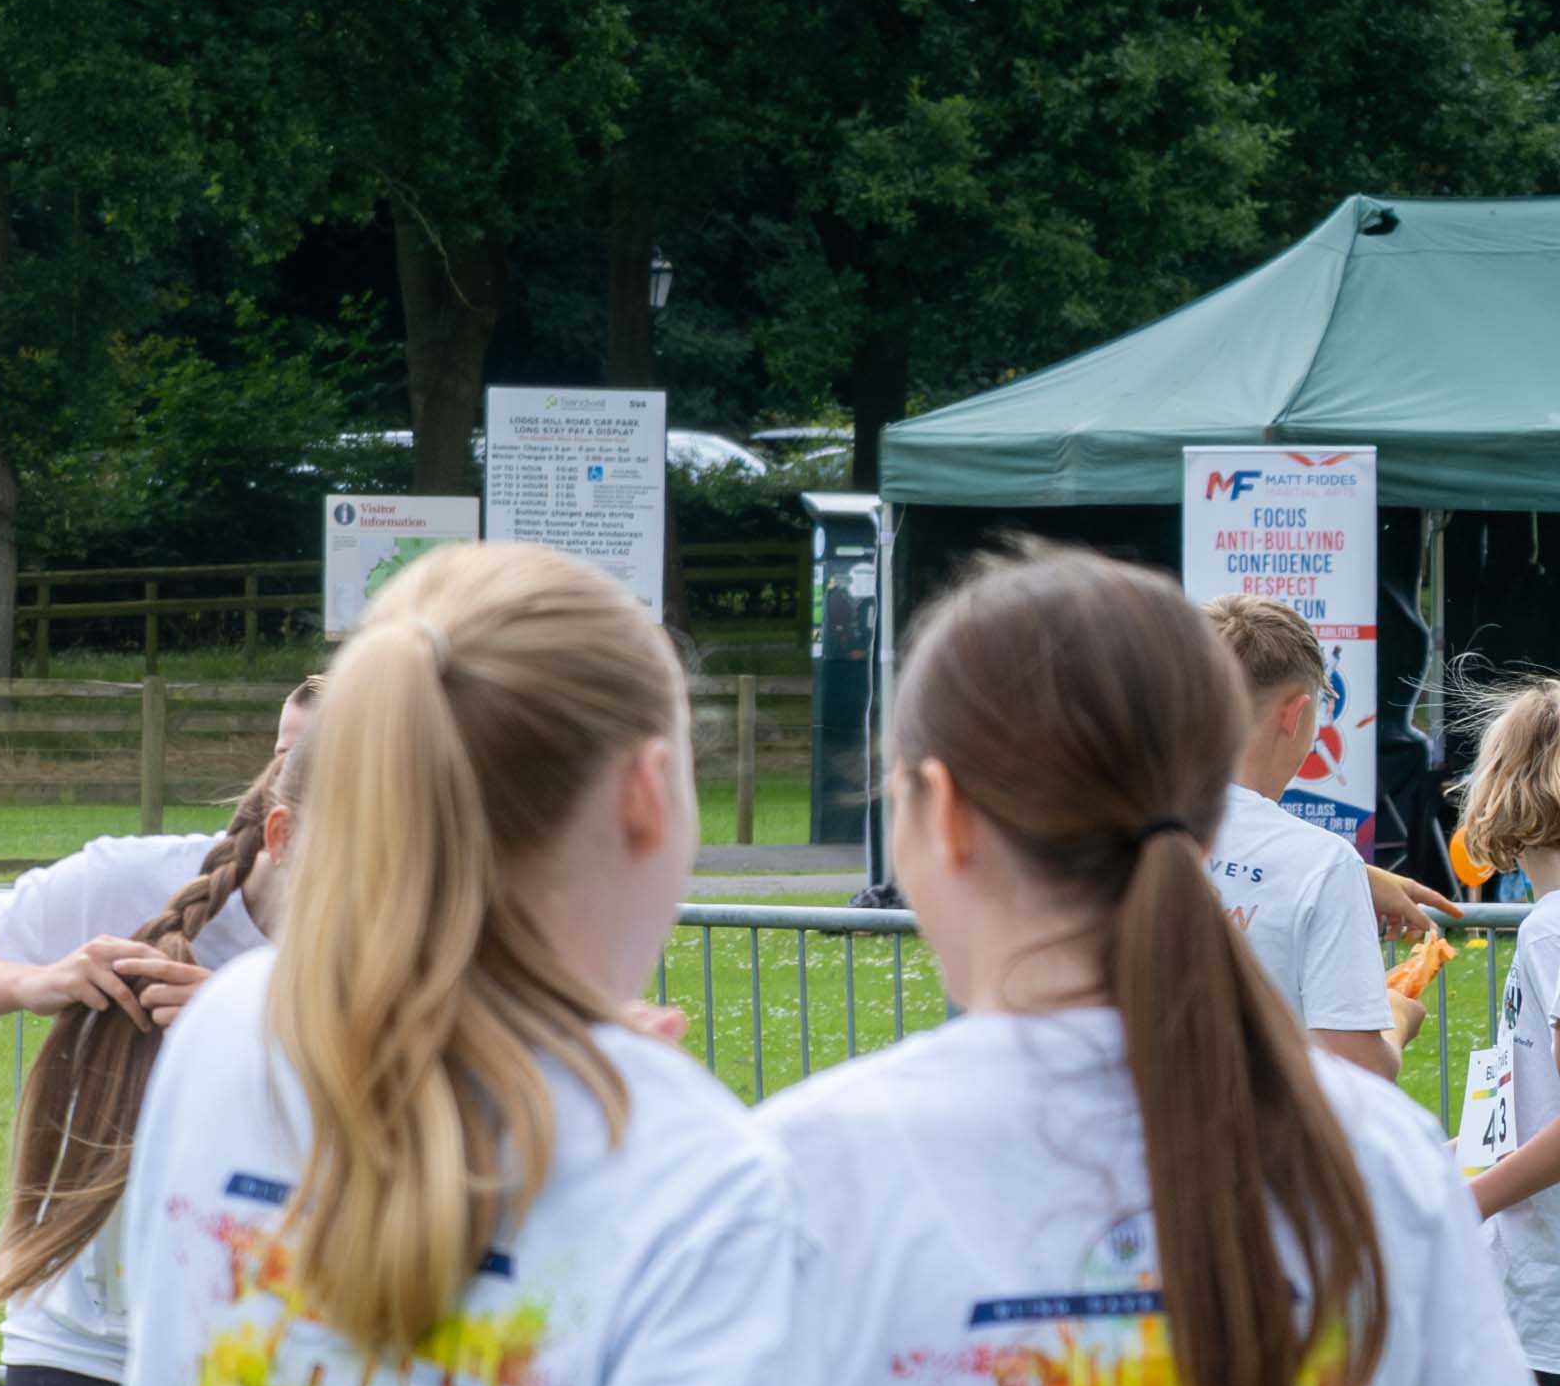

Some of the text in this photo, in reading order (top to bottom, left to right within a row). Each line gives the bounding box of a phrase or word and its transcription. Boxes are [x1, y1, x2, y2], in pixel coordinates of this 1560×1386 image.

[514, 427, 540, 435] LONG
[543, 427, 565, 435] STAY
[1206, 470, 1357, 501] MF MATT FIDDES
[360, 503, 397, 513] Visitor
[1253, 508, 1307, 528] FOCUS
[360, 517, 426, 527] Information
[1215, 531, 1345, 551] ANTI-BULLYING
[1227, 554, 1333, 574] CONFIDENCE
[1243, 576, 1318, 596] RESPECT
[1294, 599, 1326, 619] FUN
[1305, 803, 1336, 816] CLASS
[1345, 817, 1358, 831] BY
